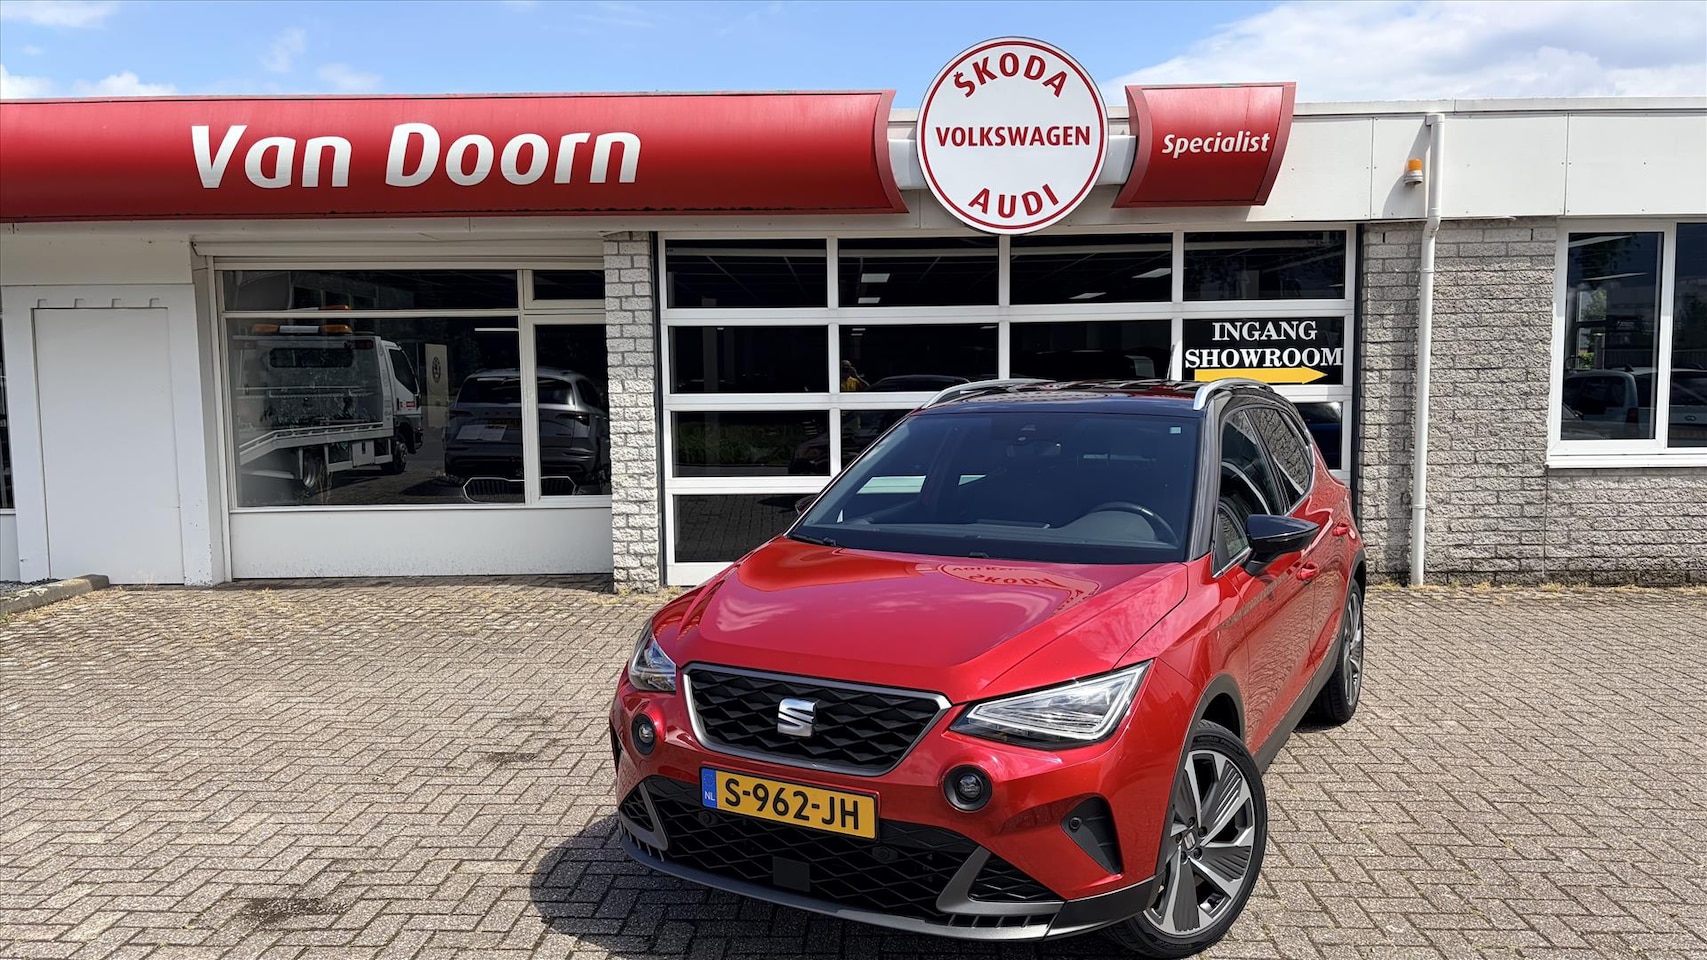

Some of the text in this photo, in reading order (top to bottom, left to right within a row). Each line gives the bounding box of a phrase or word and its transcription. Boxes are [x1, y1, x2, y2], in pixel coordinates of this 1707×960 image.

[953, 52, 1068, 98] ŠKODA
[935, 126, 1091, 147] VOLKSWAGEN
[1161, 130, 1271, 159] Specialist
[191, 122, 641, 189] Van Doorn
[968, 183, 1059, 219] AUDI
[1211, 320, 1318, 341] INGANG
[1185, 347, 1344, 369] SHOWROOM
[704, 790, 716, 801] NL
[724, 778, 859, 830] S-962-JH
